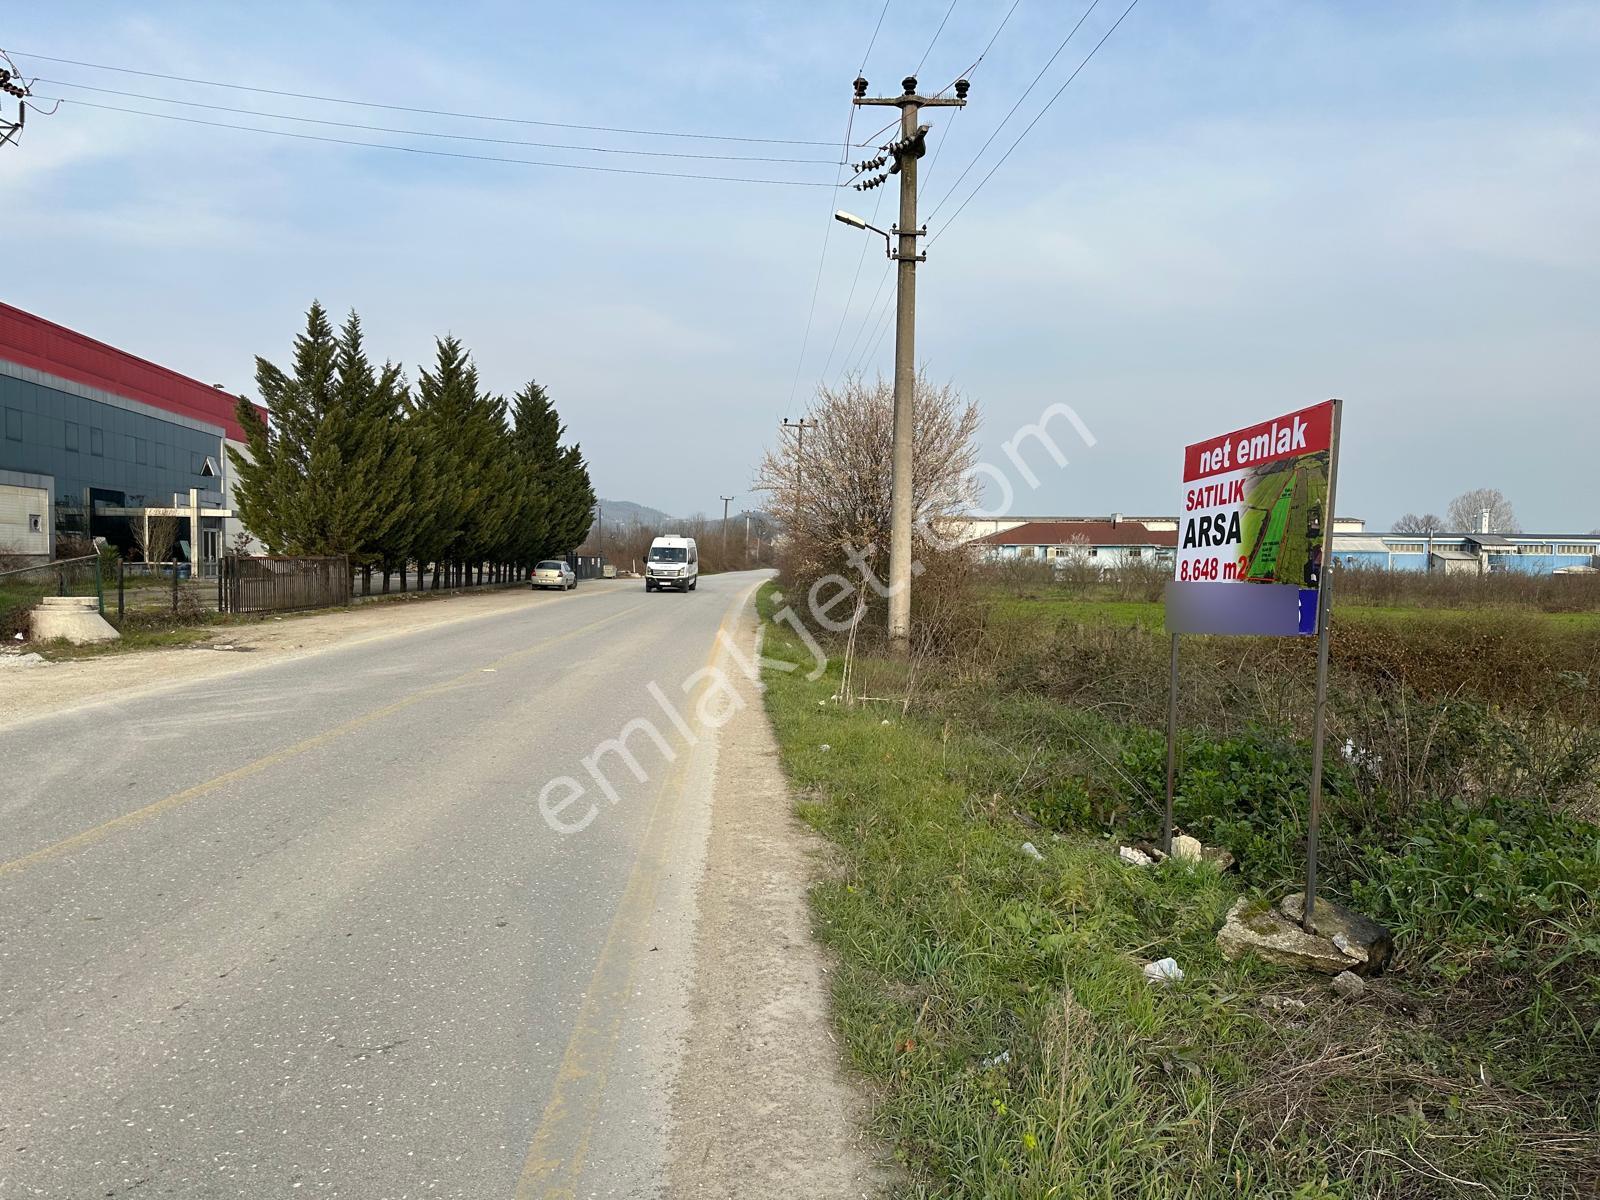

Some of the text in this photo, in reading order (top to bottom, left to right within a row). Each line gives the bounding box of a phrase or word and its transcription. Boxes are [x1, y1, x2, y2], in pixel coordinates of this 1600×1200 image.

[1199, 416, 1307, 474] net emlak
[1186, 479, 1245, 511] SATILIK
[1183, 512, 1241, 549] ARSA
[1223, 556, 1249, 580] m2
